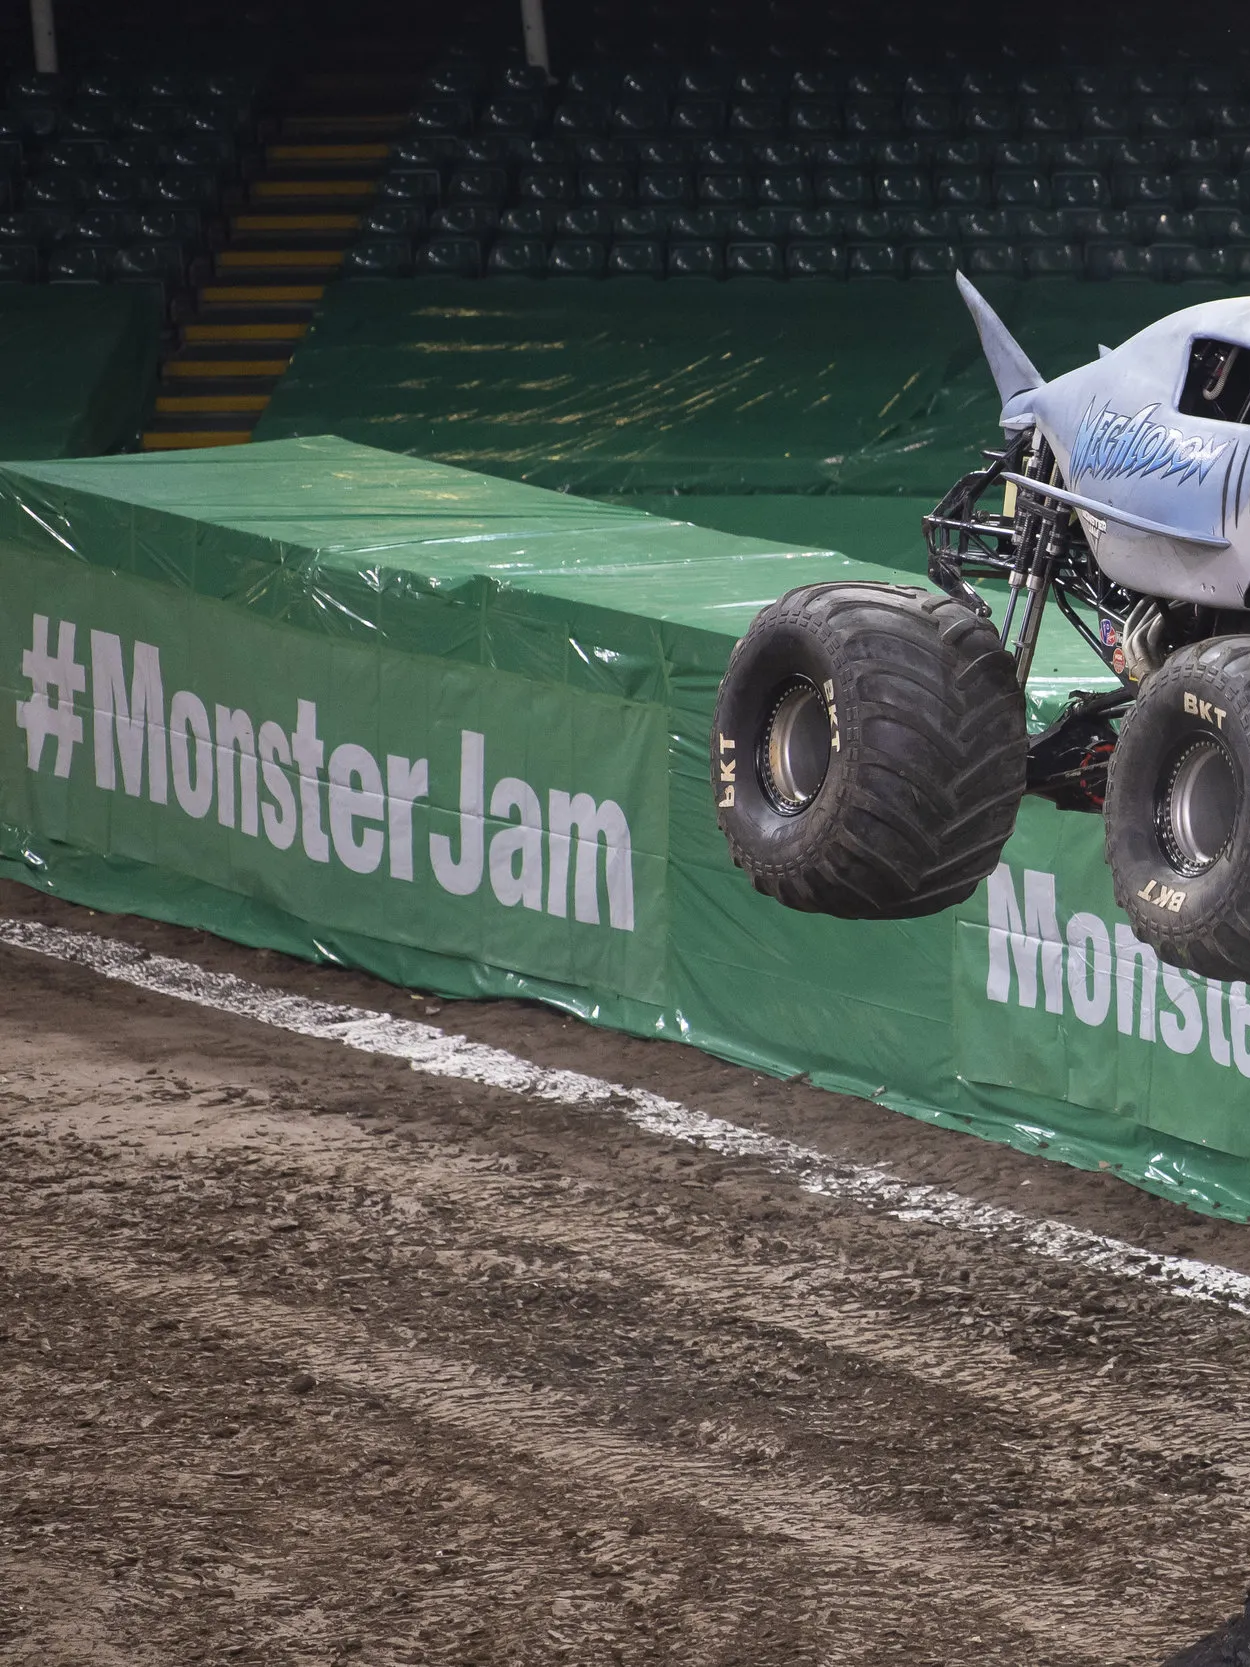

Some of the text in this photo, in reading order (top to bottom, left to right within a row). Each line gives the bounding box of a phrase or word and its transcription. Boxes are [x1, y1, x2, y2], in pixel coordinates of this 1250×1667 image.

[1183, 691, 1227, 729] BKT
[16, 613, 635, 931] #MonsterJam
[1137, 879, 1188, 913] BKT
